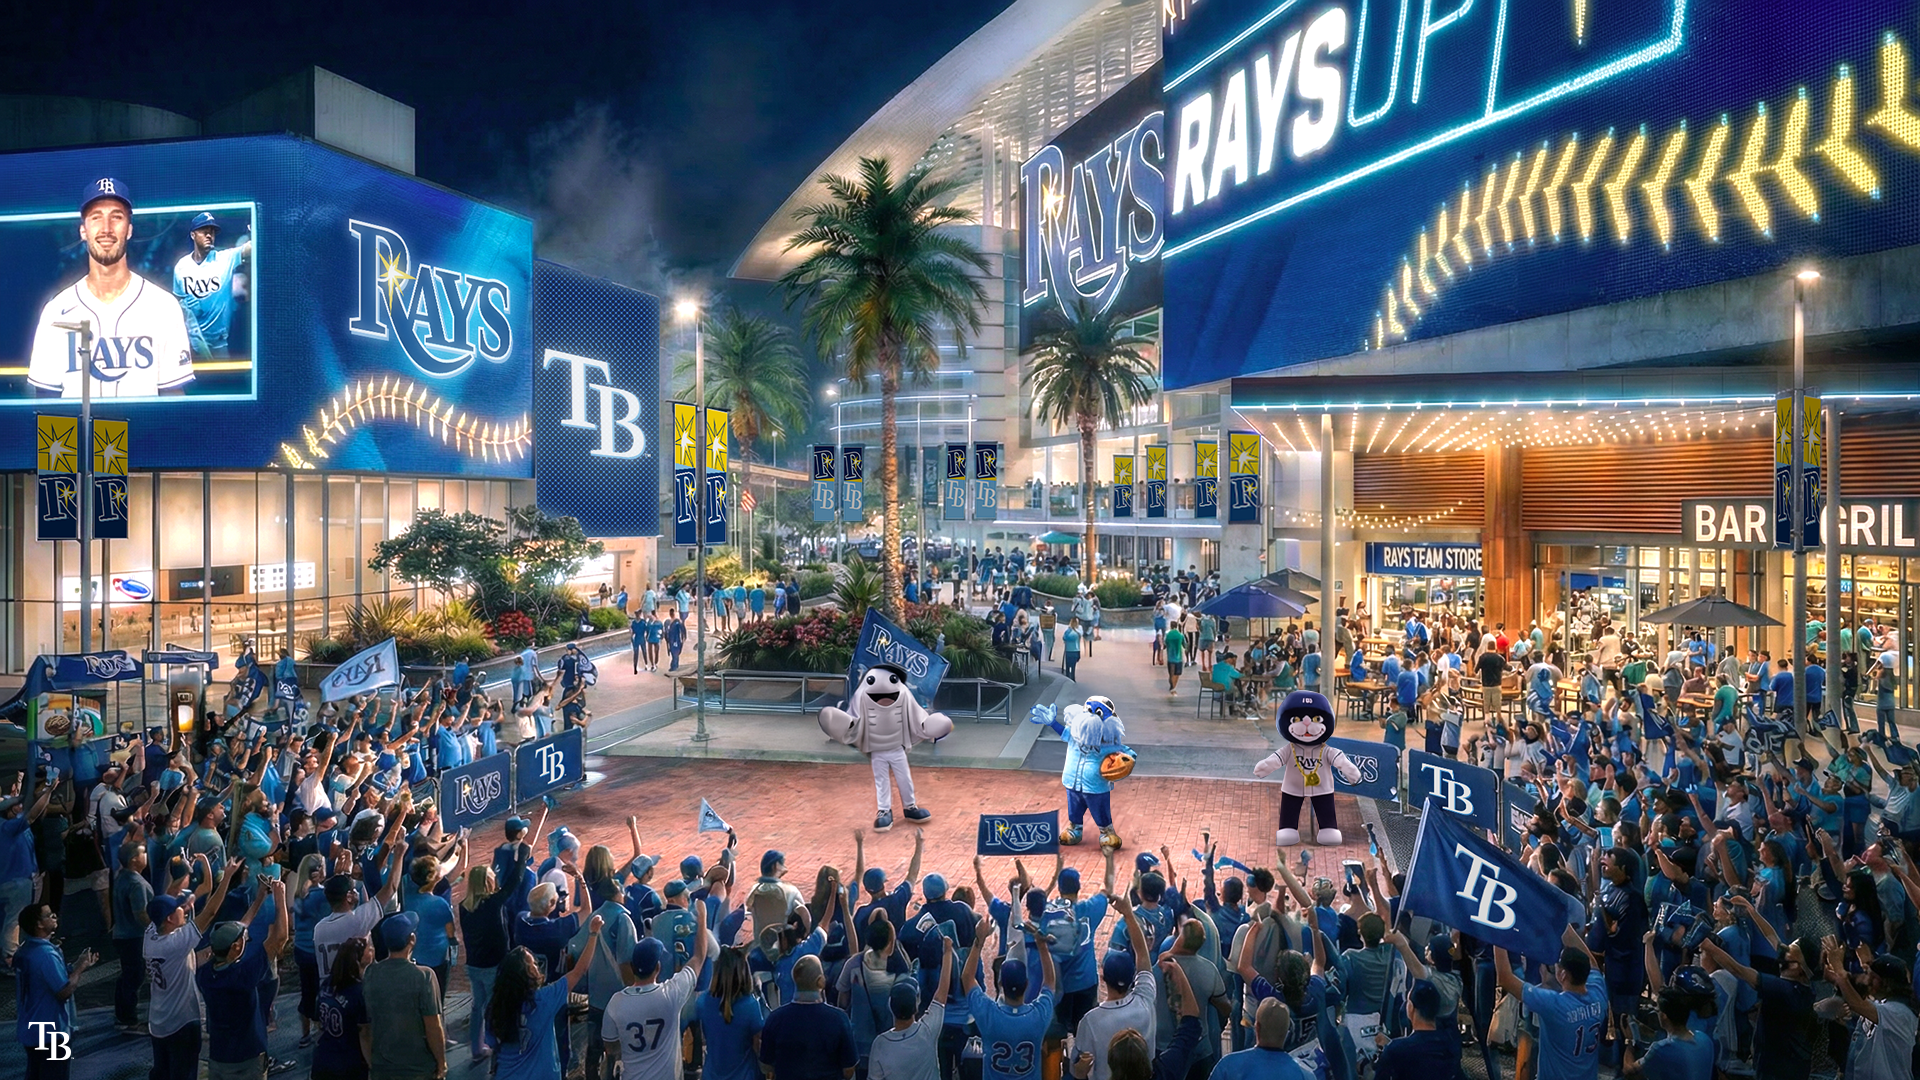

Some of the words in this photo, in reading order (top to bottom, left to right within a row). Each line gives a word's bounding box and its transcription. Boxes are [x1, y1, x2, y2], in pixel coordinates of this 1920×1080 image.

[1172, 7, 1346, 215] RAYS
[1020, 110, 1165, 322] RAYS
[183, 275, 221, 299] RAYS
[349, 218, 513, 379] RAYS
[65, 331, 154, 382] RAYS
[543, 348, 646, 459] TB
[1695, 504, 1767, 543] BAR
[1383, 546, 1411, 568] RAYS
[1412, 547, 1443, 569] TEAM
[1445, 548, 1483, 571] STORE
[866, 623, 929, 678] RAYS
[534, 743, 565, 785] TB
[454, 770, 501, 815] RAYS
[1421, 763, 1474, 816] TB
[985, 818, 1051, 852] RAYS
[1455, 843, 1519, 931] TB
[625, 1017, 665, 1053] 37
[991, 1040, 1035, 1075] 23
